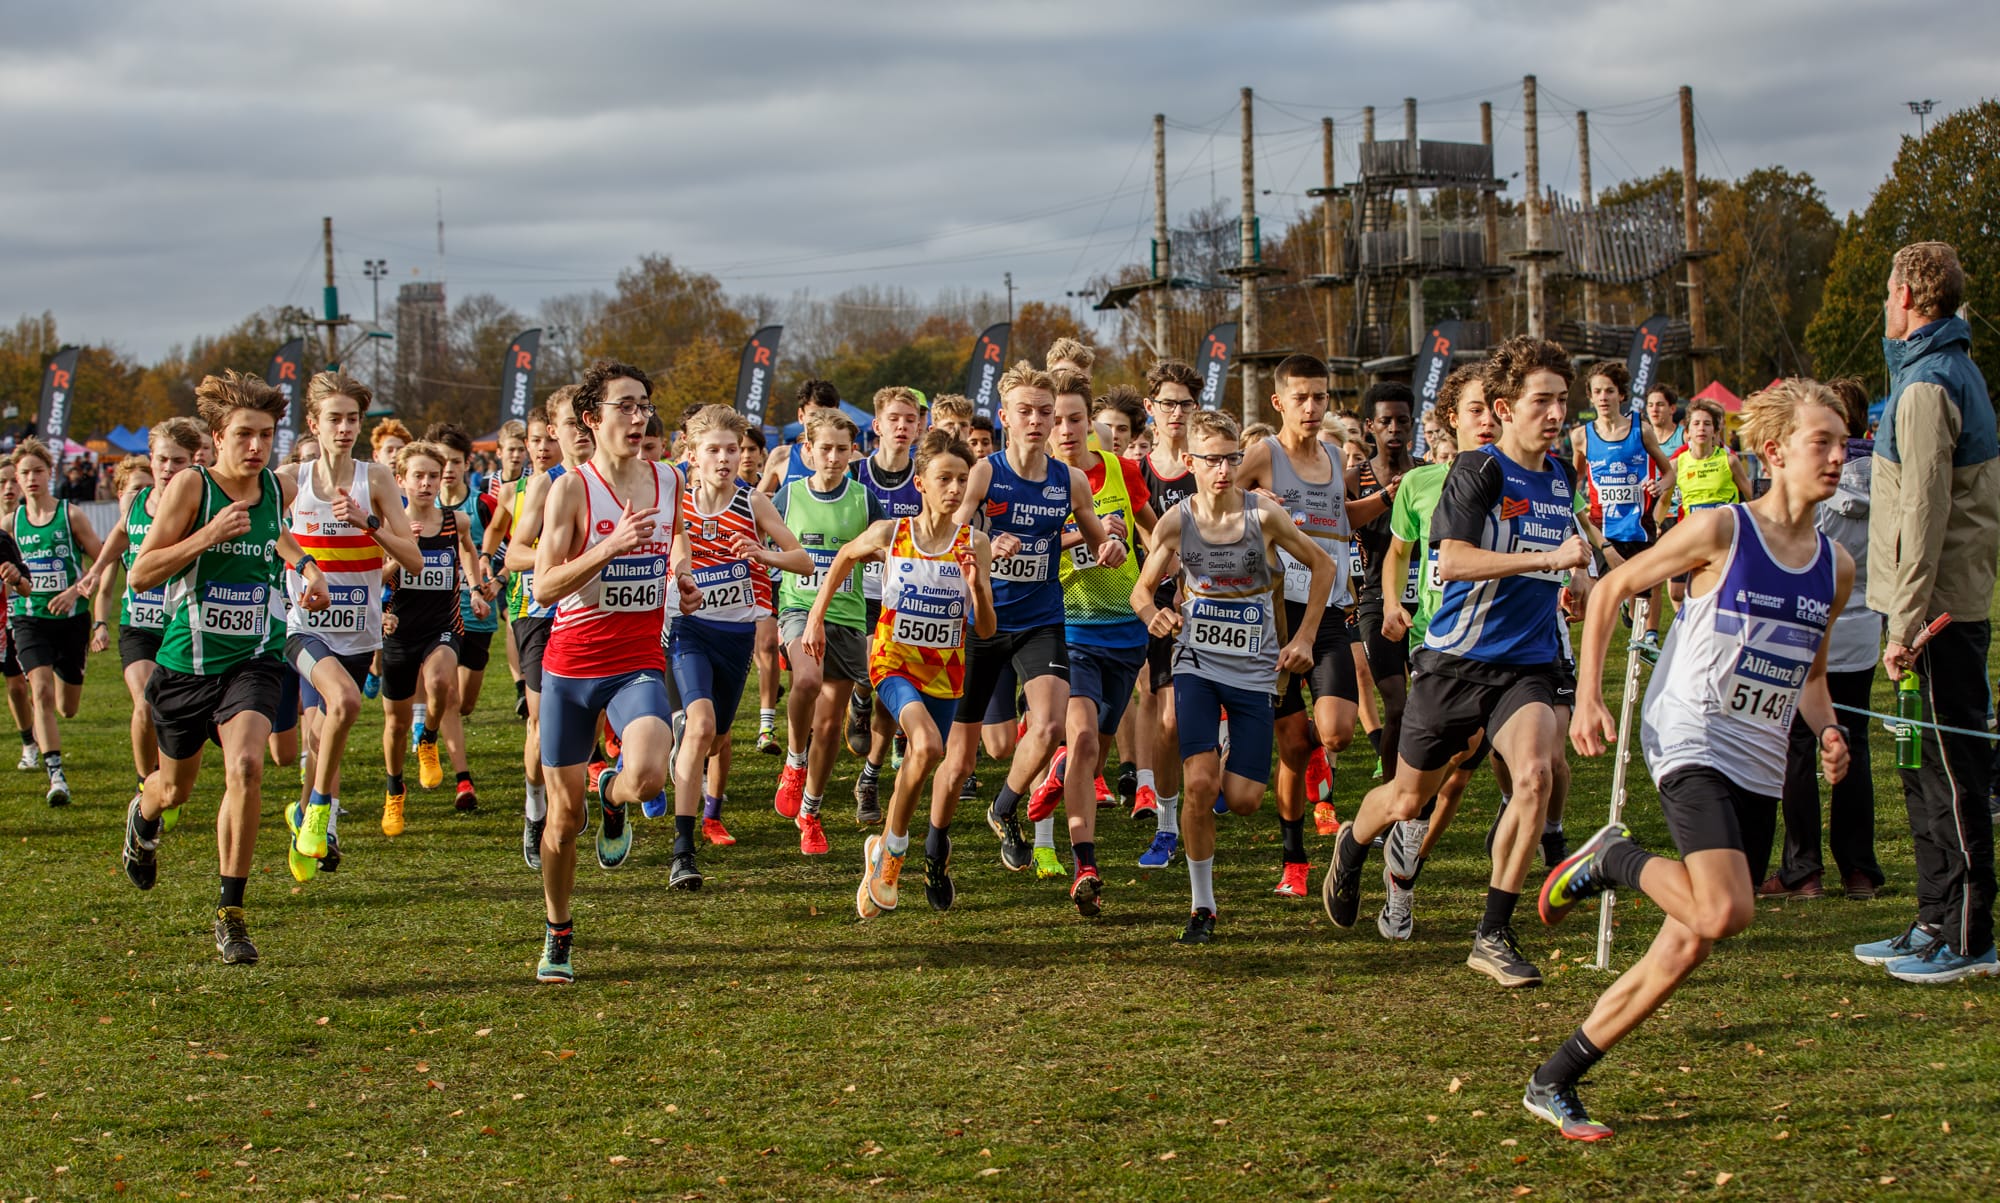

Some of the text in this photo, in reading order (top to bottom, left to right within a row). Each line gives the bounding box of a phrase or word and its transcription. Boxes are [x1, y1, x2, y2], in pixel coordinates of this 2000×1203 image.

[1202, 361, 1221, 402] Store
[1422, 357, 1444, 399] Store
[1633, 353, 1652, 396] Store
[510, 372, 528, 416] Store
[746, 367, 765, 411] Store
[976, 363, 996, 406] Store
[47, 391, 65, 436] Store
[1601, 489, 1632, 501] 5032
[893, 503, 919, 512] DOMO
[1013, 503, 1069, 517] runners'
[1011, 512, 1035, 526] lab
[1309, 513, 1337, 527] Tereos
[18, 534, 40, 545] VAC
[1523, 521, 1562, 540] Allianz
[605, 564, 652, 579] Allianz
[1213, 575, 1253, 587] Tereos
[208, 586, 251, 602] Allianz
[604, 584, 657, 607] 5646
[922, 585, 961, 599] Running
[901, 597, 946, 616] Allianz
[1197, 603, 1241, 619] Allianz
[205, 608, 258, 631] 5638
[308, 609, 354, 628] 5206
[897, 618, 950, 644] 5505
[1195, 624, 1247, 649] 5846
[1740, 655, 1793, 682] Allianz
[1730, 683, 1787, 720] 5143
